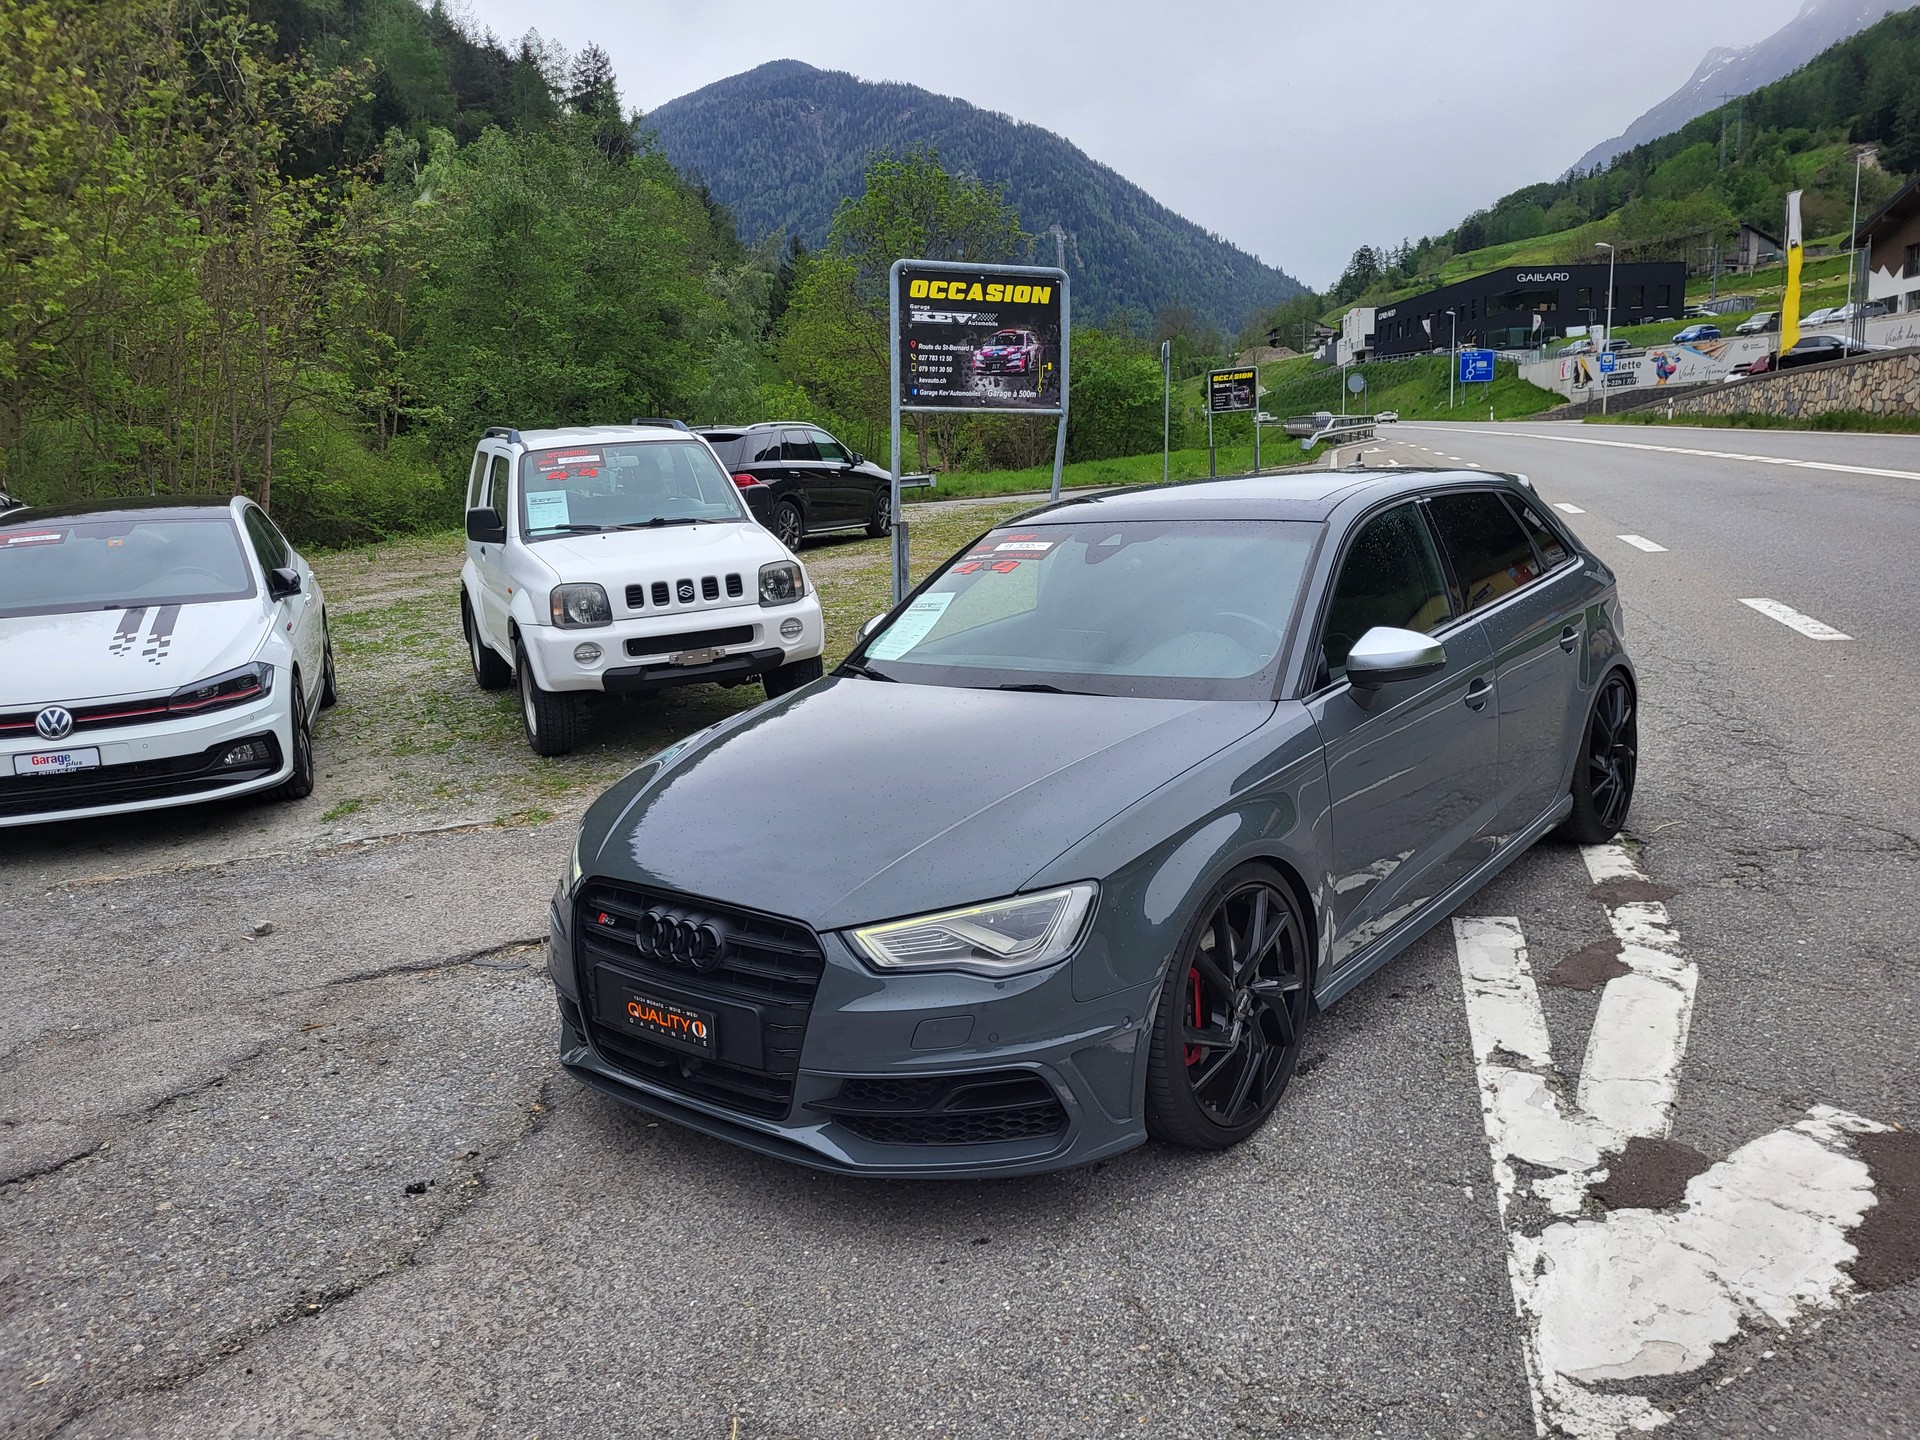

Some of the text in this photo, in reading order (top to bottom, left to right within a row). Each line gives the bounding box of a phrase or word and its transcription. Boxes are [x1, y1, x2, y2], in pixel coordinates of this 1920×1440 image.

[1516, 272, 1570, 282] GAILLARD
[909, 279, 1052, 304] OCCASION
[1213, 372, 1253, 382] OCCASION
[919, 389, 938, 398] Garage
[987, 389, 1012, 399] Garage
[1018, 390, 1037, 398] 500m
[31, 754, 71, 766] Garage
[65, 760, 83, 768] plus
[628, 1002, 691, 1033] QUALITY
[629, 1017, 708, 1047] GARANTIE
